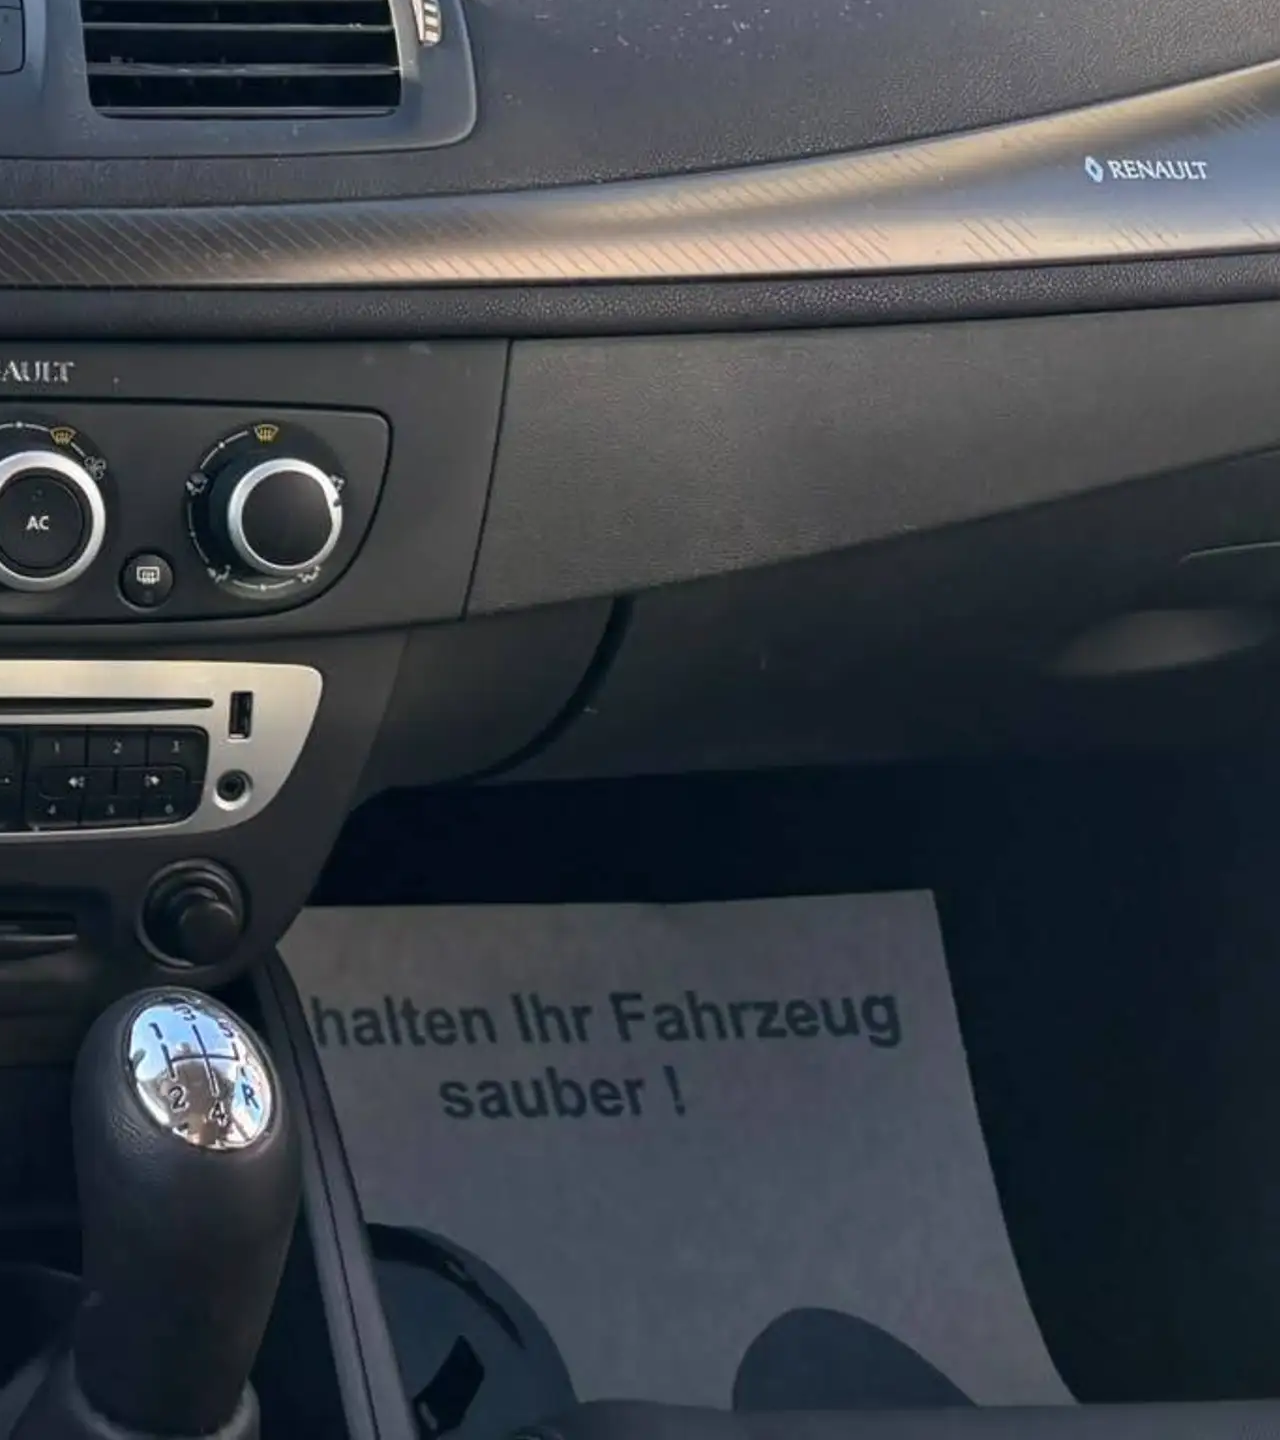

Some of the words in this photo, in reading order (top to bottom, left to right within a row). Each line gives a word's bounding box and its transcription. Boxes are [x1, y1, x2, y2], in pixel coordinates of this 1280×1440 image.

[1107, 159, 1208, 180] RENAULT
[26, 515, 51, 531] AC
[53, 741, 60, 753] 1
[112, 741, 122, 754] 2
[312, 995, 497, 1049] halten
[511, 994, 592, 1044] Ihr
[610, 990, 903, 1048] Fahrzeug
[167, 1084, 189, 1112] 2
[240, 1083, 261, 1111] R
[440, 1065, 645, 1119] sauber
[663, 1065, 687, 1116] !
[208, 1099, 229, 1127] 4
